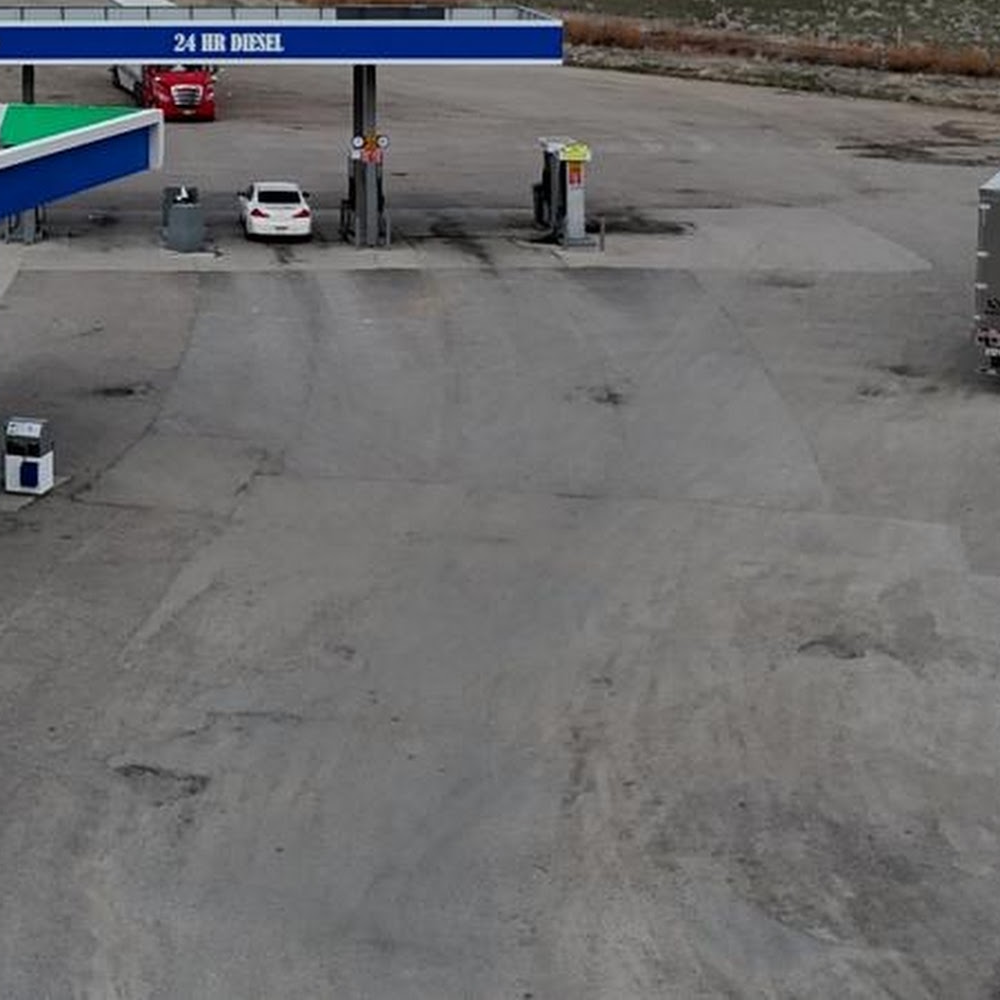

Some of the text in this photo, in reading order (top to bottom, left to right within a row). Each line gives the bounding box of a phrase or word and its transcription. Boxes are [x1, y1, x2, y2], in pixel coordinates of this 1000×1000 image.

[174, 33, 285, 52] 24 HR DIESEL
